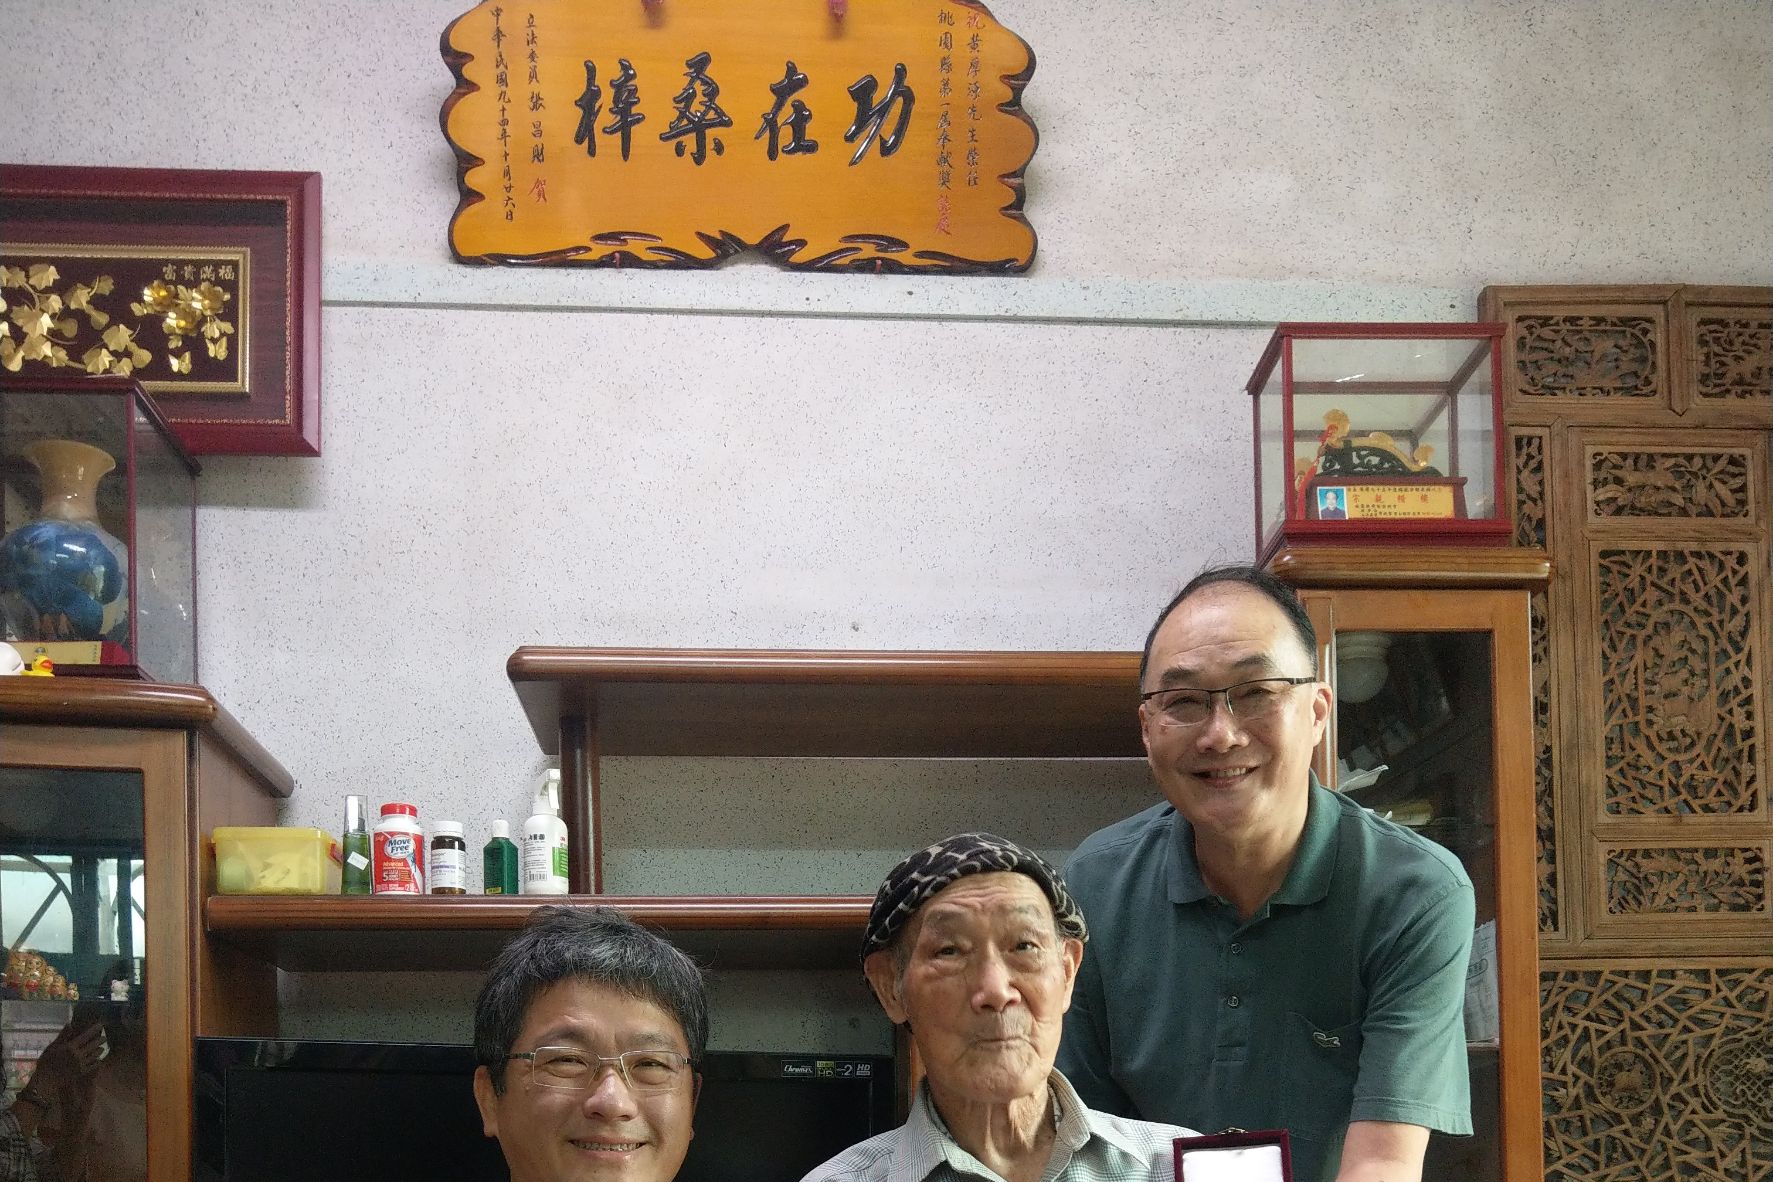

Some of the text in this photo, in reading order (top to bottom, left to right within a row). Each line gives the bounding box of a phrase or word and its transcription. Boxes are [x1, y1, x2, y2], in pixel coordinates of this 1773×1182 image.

[574, 51, 916, 166] 功在桑梓
[388, 839, 411, 847] Move
